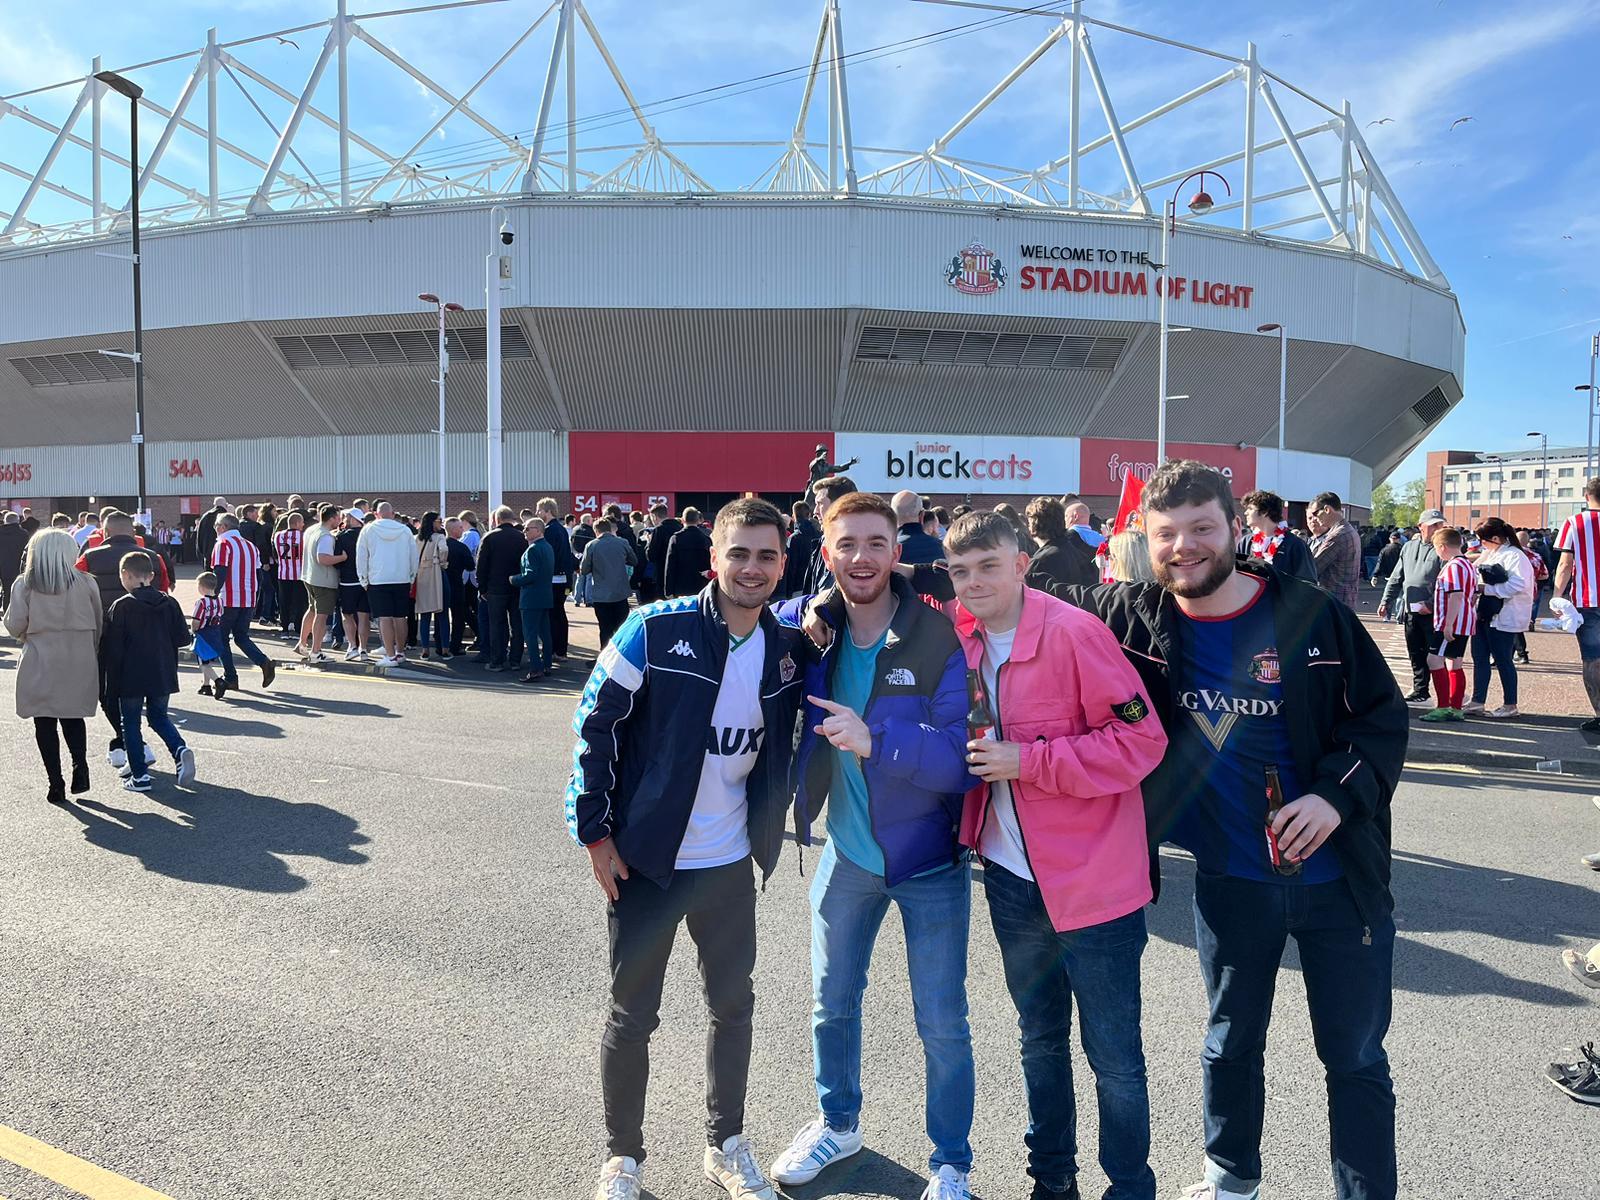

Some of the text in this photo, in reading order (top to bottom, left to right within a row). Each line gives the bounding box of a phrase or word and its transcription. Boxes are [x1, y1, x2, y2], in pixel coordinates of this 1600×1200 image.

[1020, 244, 1148, 265] WELCOME TO THE
[1020, 265, 1253, 309] STADIUM OF LIGHT
[915, 441, 951, 455] junior
[169, 458, 203, 478] 54A
[887, 449, 1032, 480] blackcats
[574, 495, 598, 512] 54
